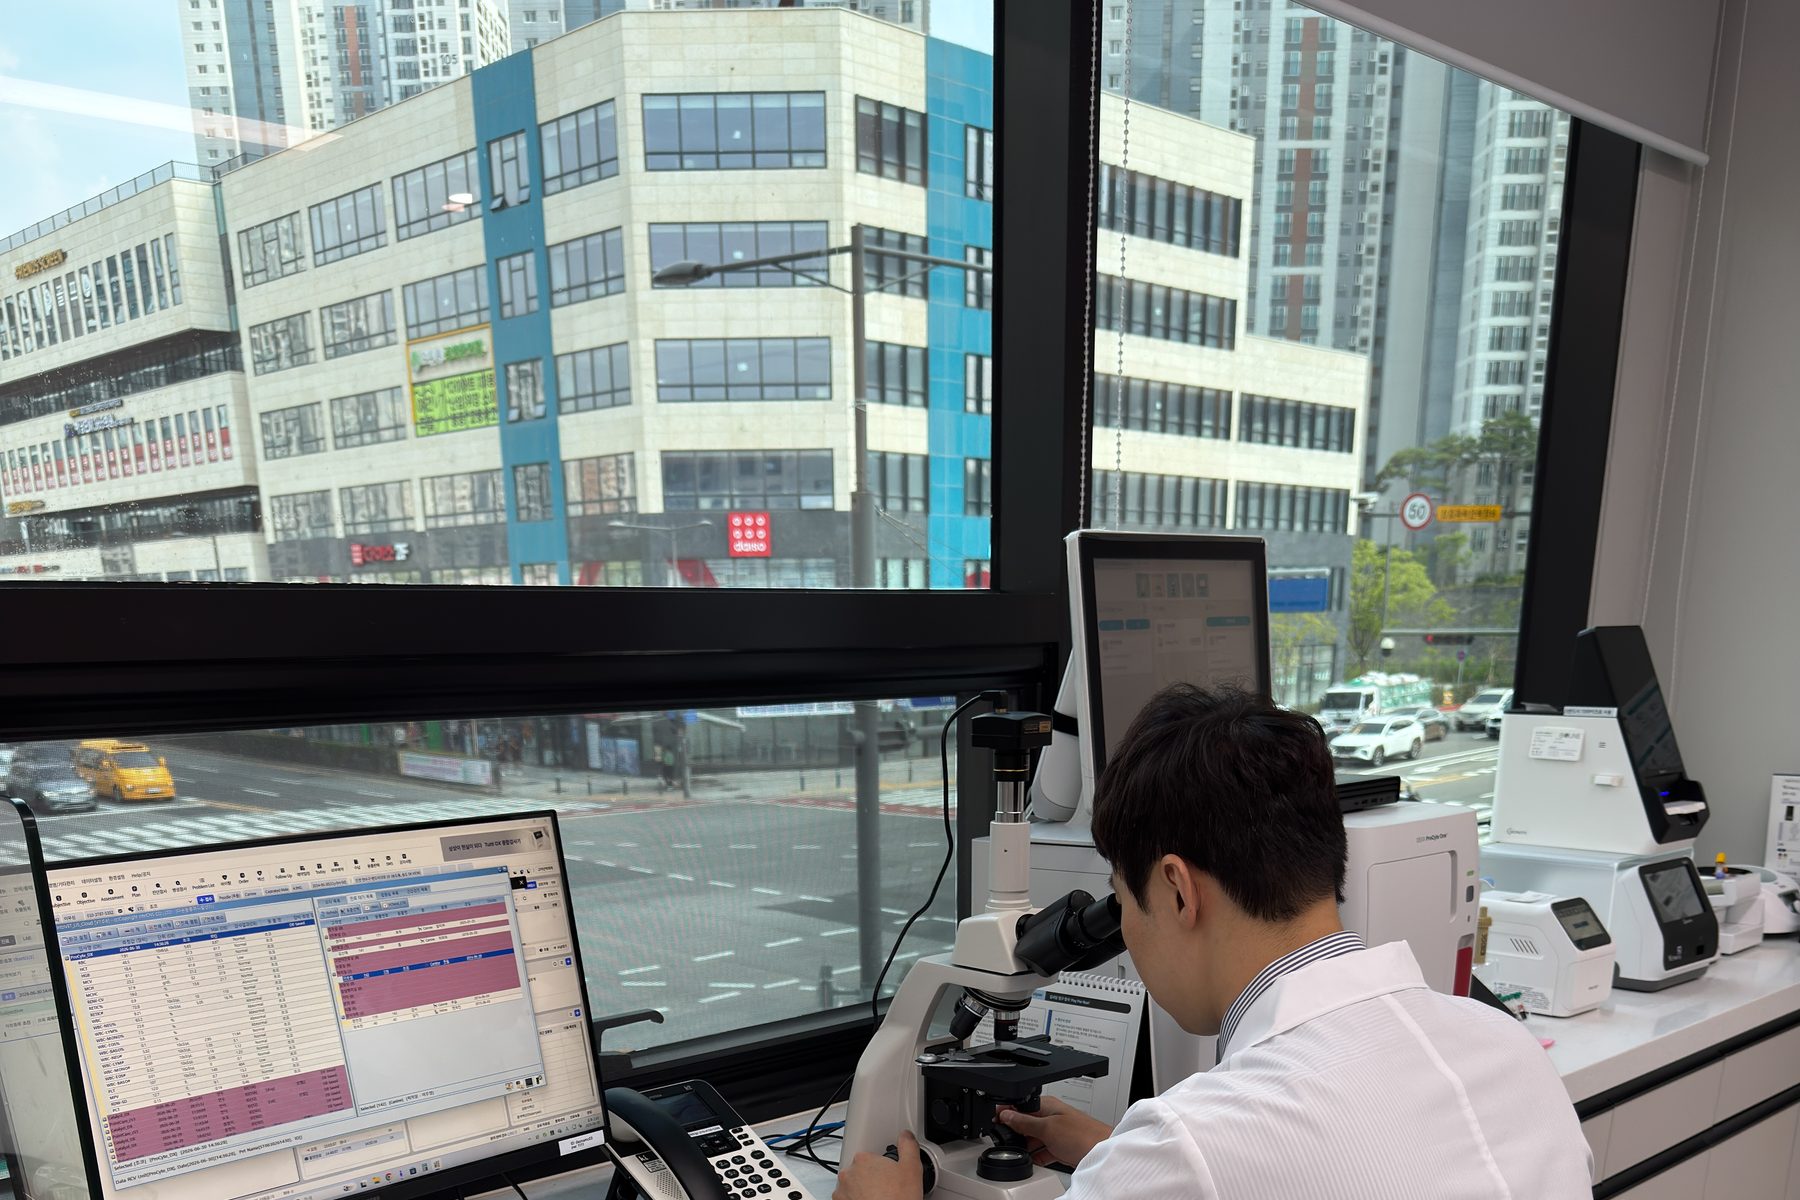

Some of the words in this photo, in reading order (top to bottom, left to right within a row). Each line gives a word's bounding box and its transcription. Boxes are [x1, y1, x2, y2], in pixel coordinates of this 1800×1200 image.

[1408, 503, 1426, 520] 50
[733, 540, 767, 552] daiso
[75, 898, 96, 906] Objective
[100, 894, 124, 902] Assessment
